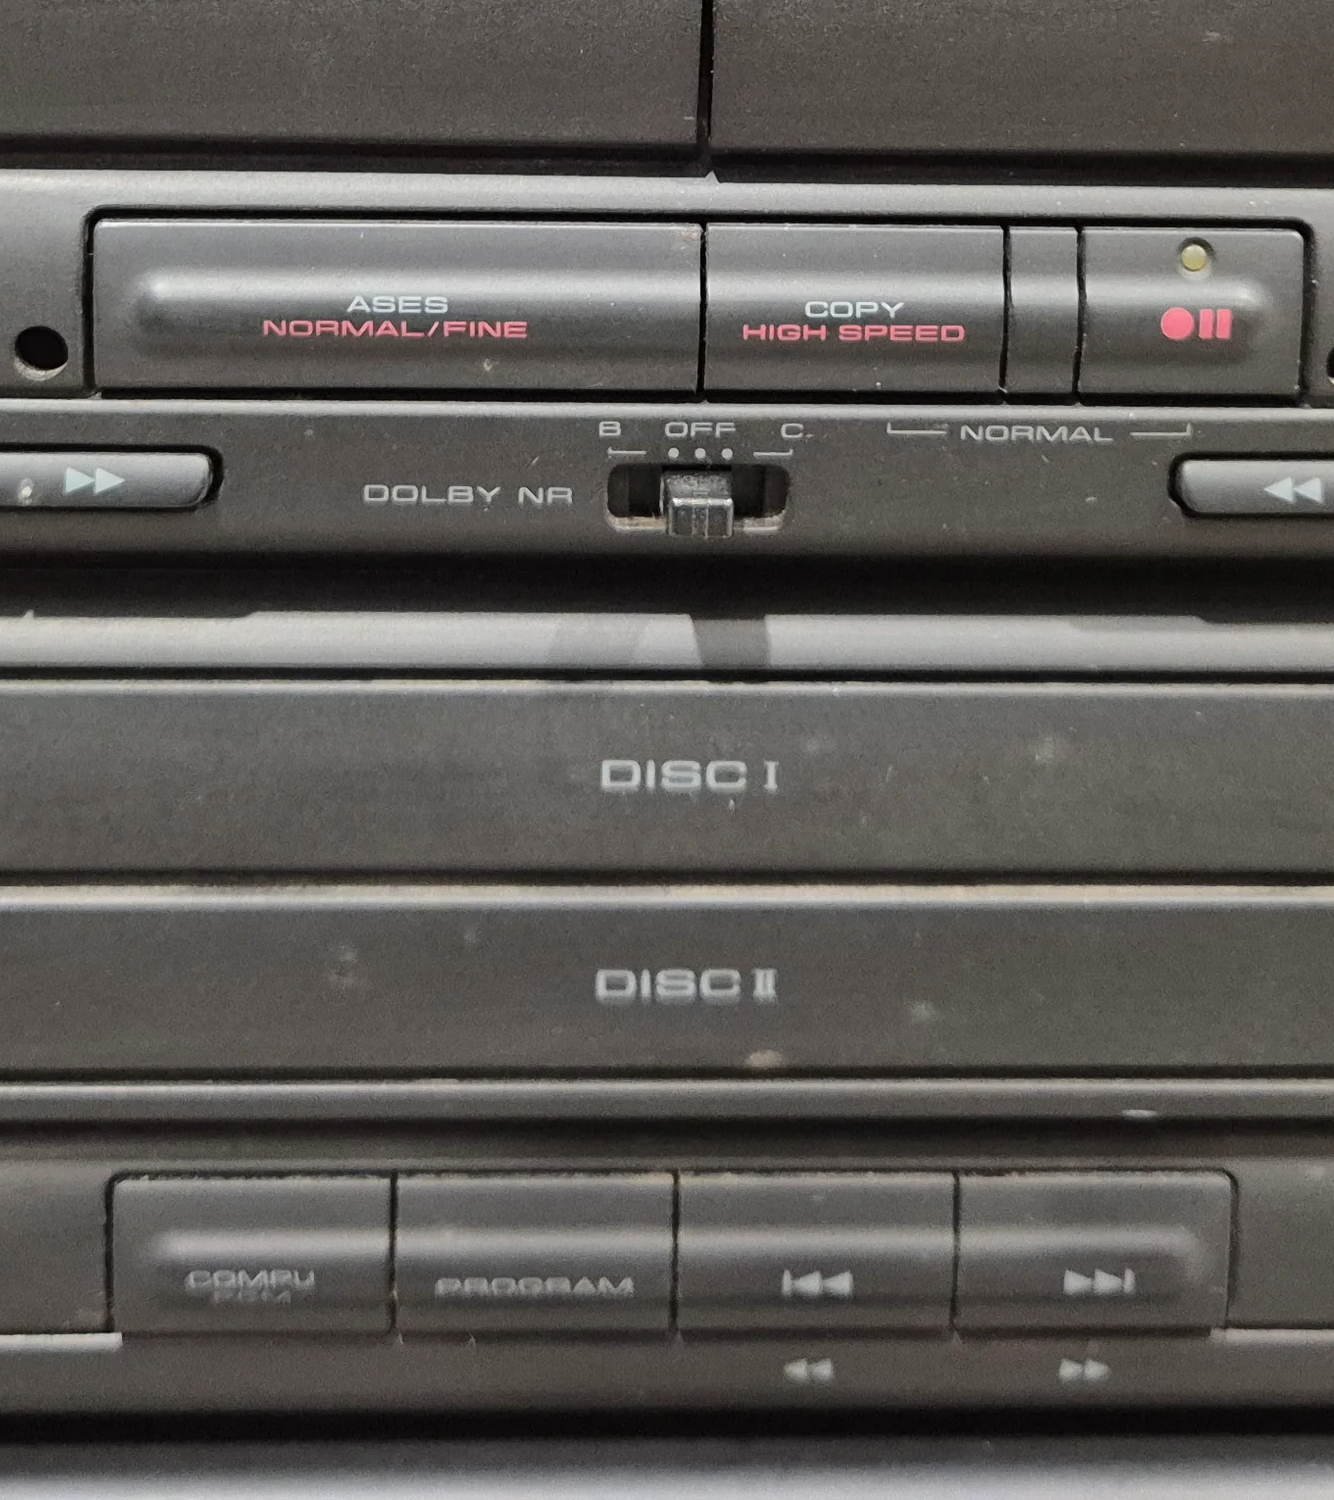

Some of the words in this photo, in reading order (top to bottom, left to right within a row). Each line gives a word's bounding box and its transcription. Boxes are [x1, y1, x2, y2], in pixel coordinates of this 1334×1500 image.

[346, 296, 448, 315] ASES
[804, 300, 905, 321] COPY
[262, 319, 527, 340] NORMAL/FINE
[742, 323, 828, 343] HIGH
[838, 324, 965, 343] SPEED
[598, 421, 622, 438] B
[665, 422, 736, 439] OFF
[780, 423, 805, 439] C
[959, 424, 1113, 444] NORMAL
[363, 484, 500, 505] DOLBY
[518, 486, 573, 506] NR
[600, 759, 747, 794] DISC
[595, 968, 742, 1003] DISC
[434, 1276, 635, 1299] PROGRAM
